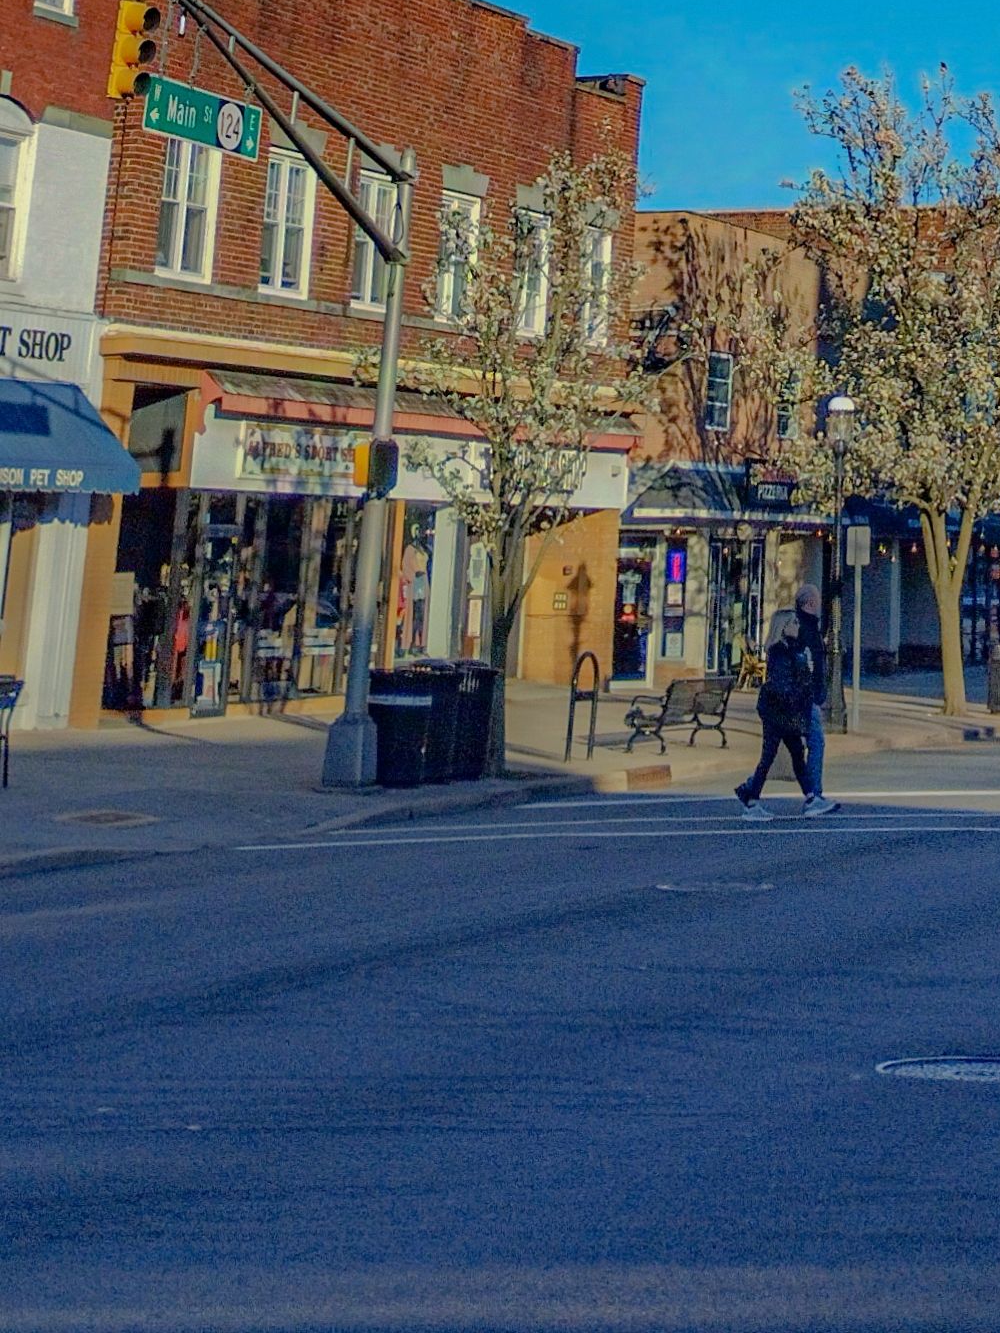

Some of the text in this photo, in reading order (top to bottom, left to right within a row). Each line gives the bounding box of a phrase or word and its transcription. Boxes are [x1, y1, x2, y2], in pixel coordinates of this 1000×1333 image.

[167, 94, 213, 128] Main St
[220, 111, 241, 141] 124
[249, 113, 256, 130] E
[18, 328, 71, 362] SHOP
[30, 468, 50, 486] PET
[55, 469, 84, 486] SHOP
